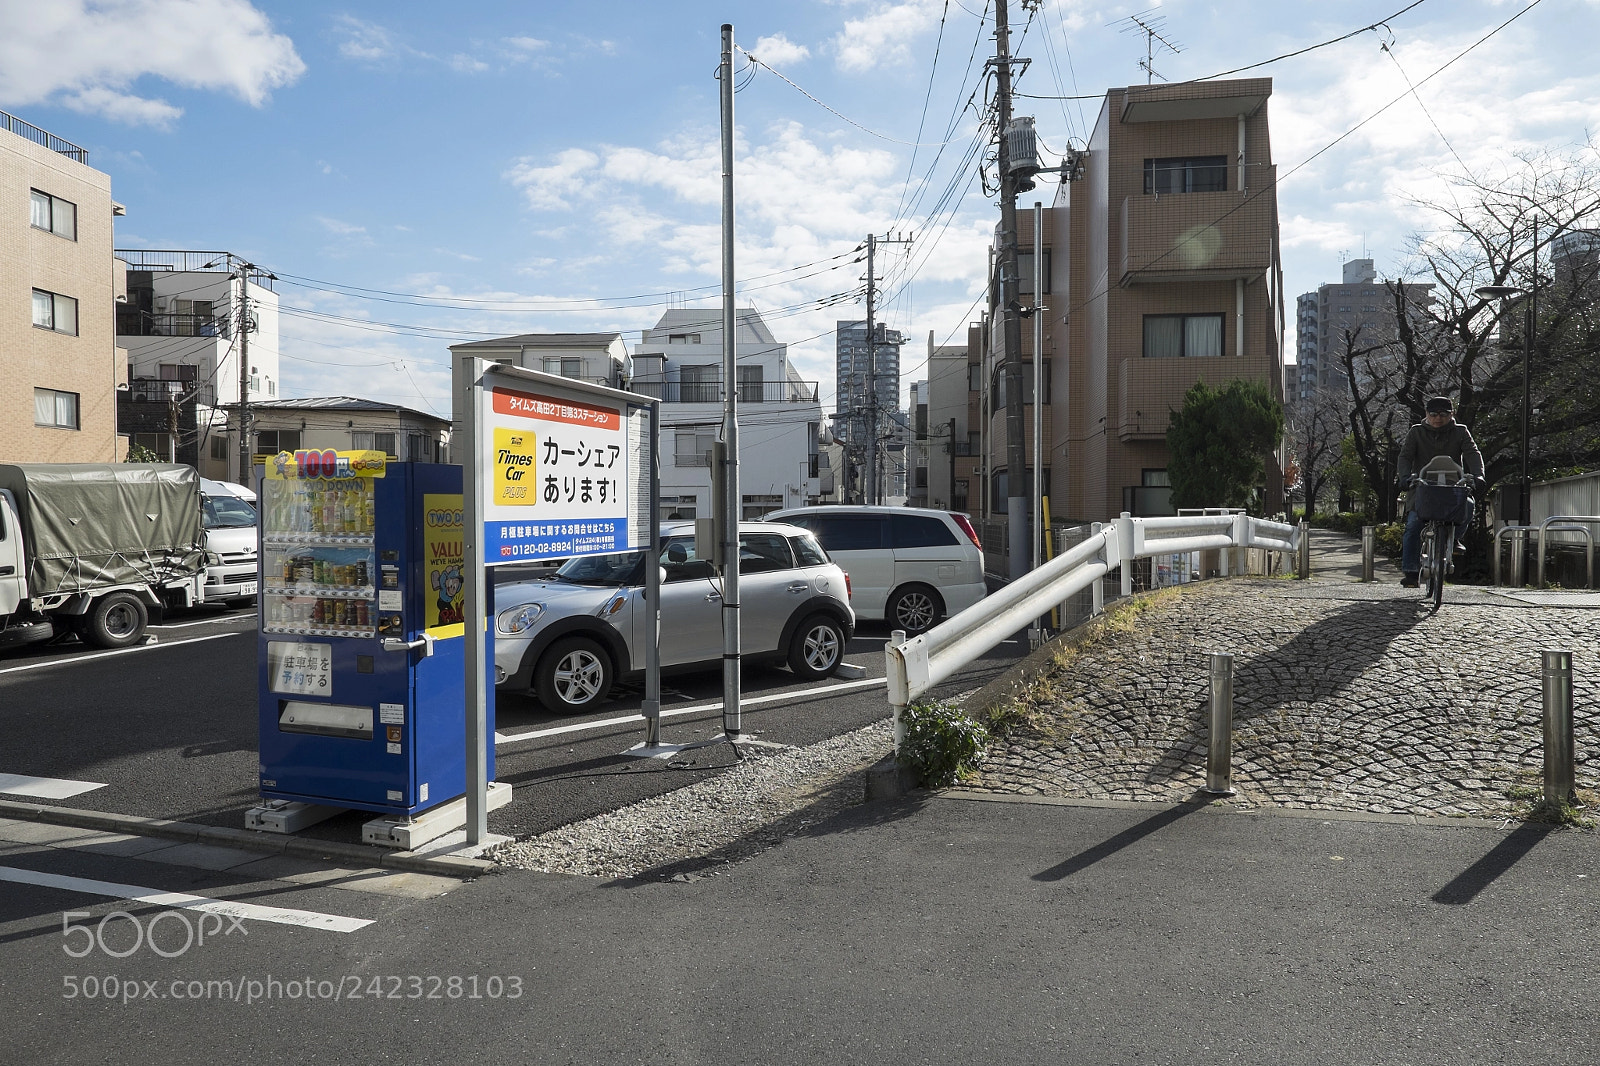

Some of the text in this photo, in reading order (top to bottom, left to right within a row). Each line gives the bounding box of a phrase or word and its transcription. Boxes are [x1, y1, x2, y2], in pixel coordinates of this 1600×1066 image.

[498, 449, 533, 466] Times
[543, 436, 620, 469] カーシェア
[506, 466, 526, 481] Car
[503, 486, 527, 499] PLUS
[543, 474, 617, 504] あります!
[430, 512, 452, 524] TWO
[500, 523, 615, 539] 月極駐車場に関するお問合せはこちら
[512, 542, 572, 556] 0120-02-8924
[284, 655, 330, 671] 駐車場を
[282, 671, 327, 688] 予約する
